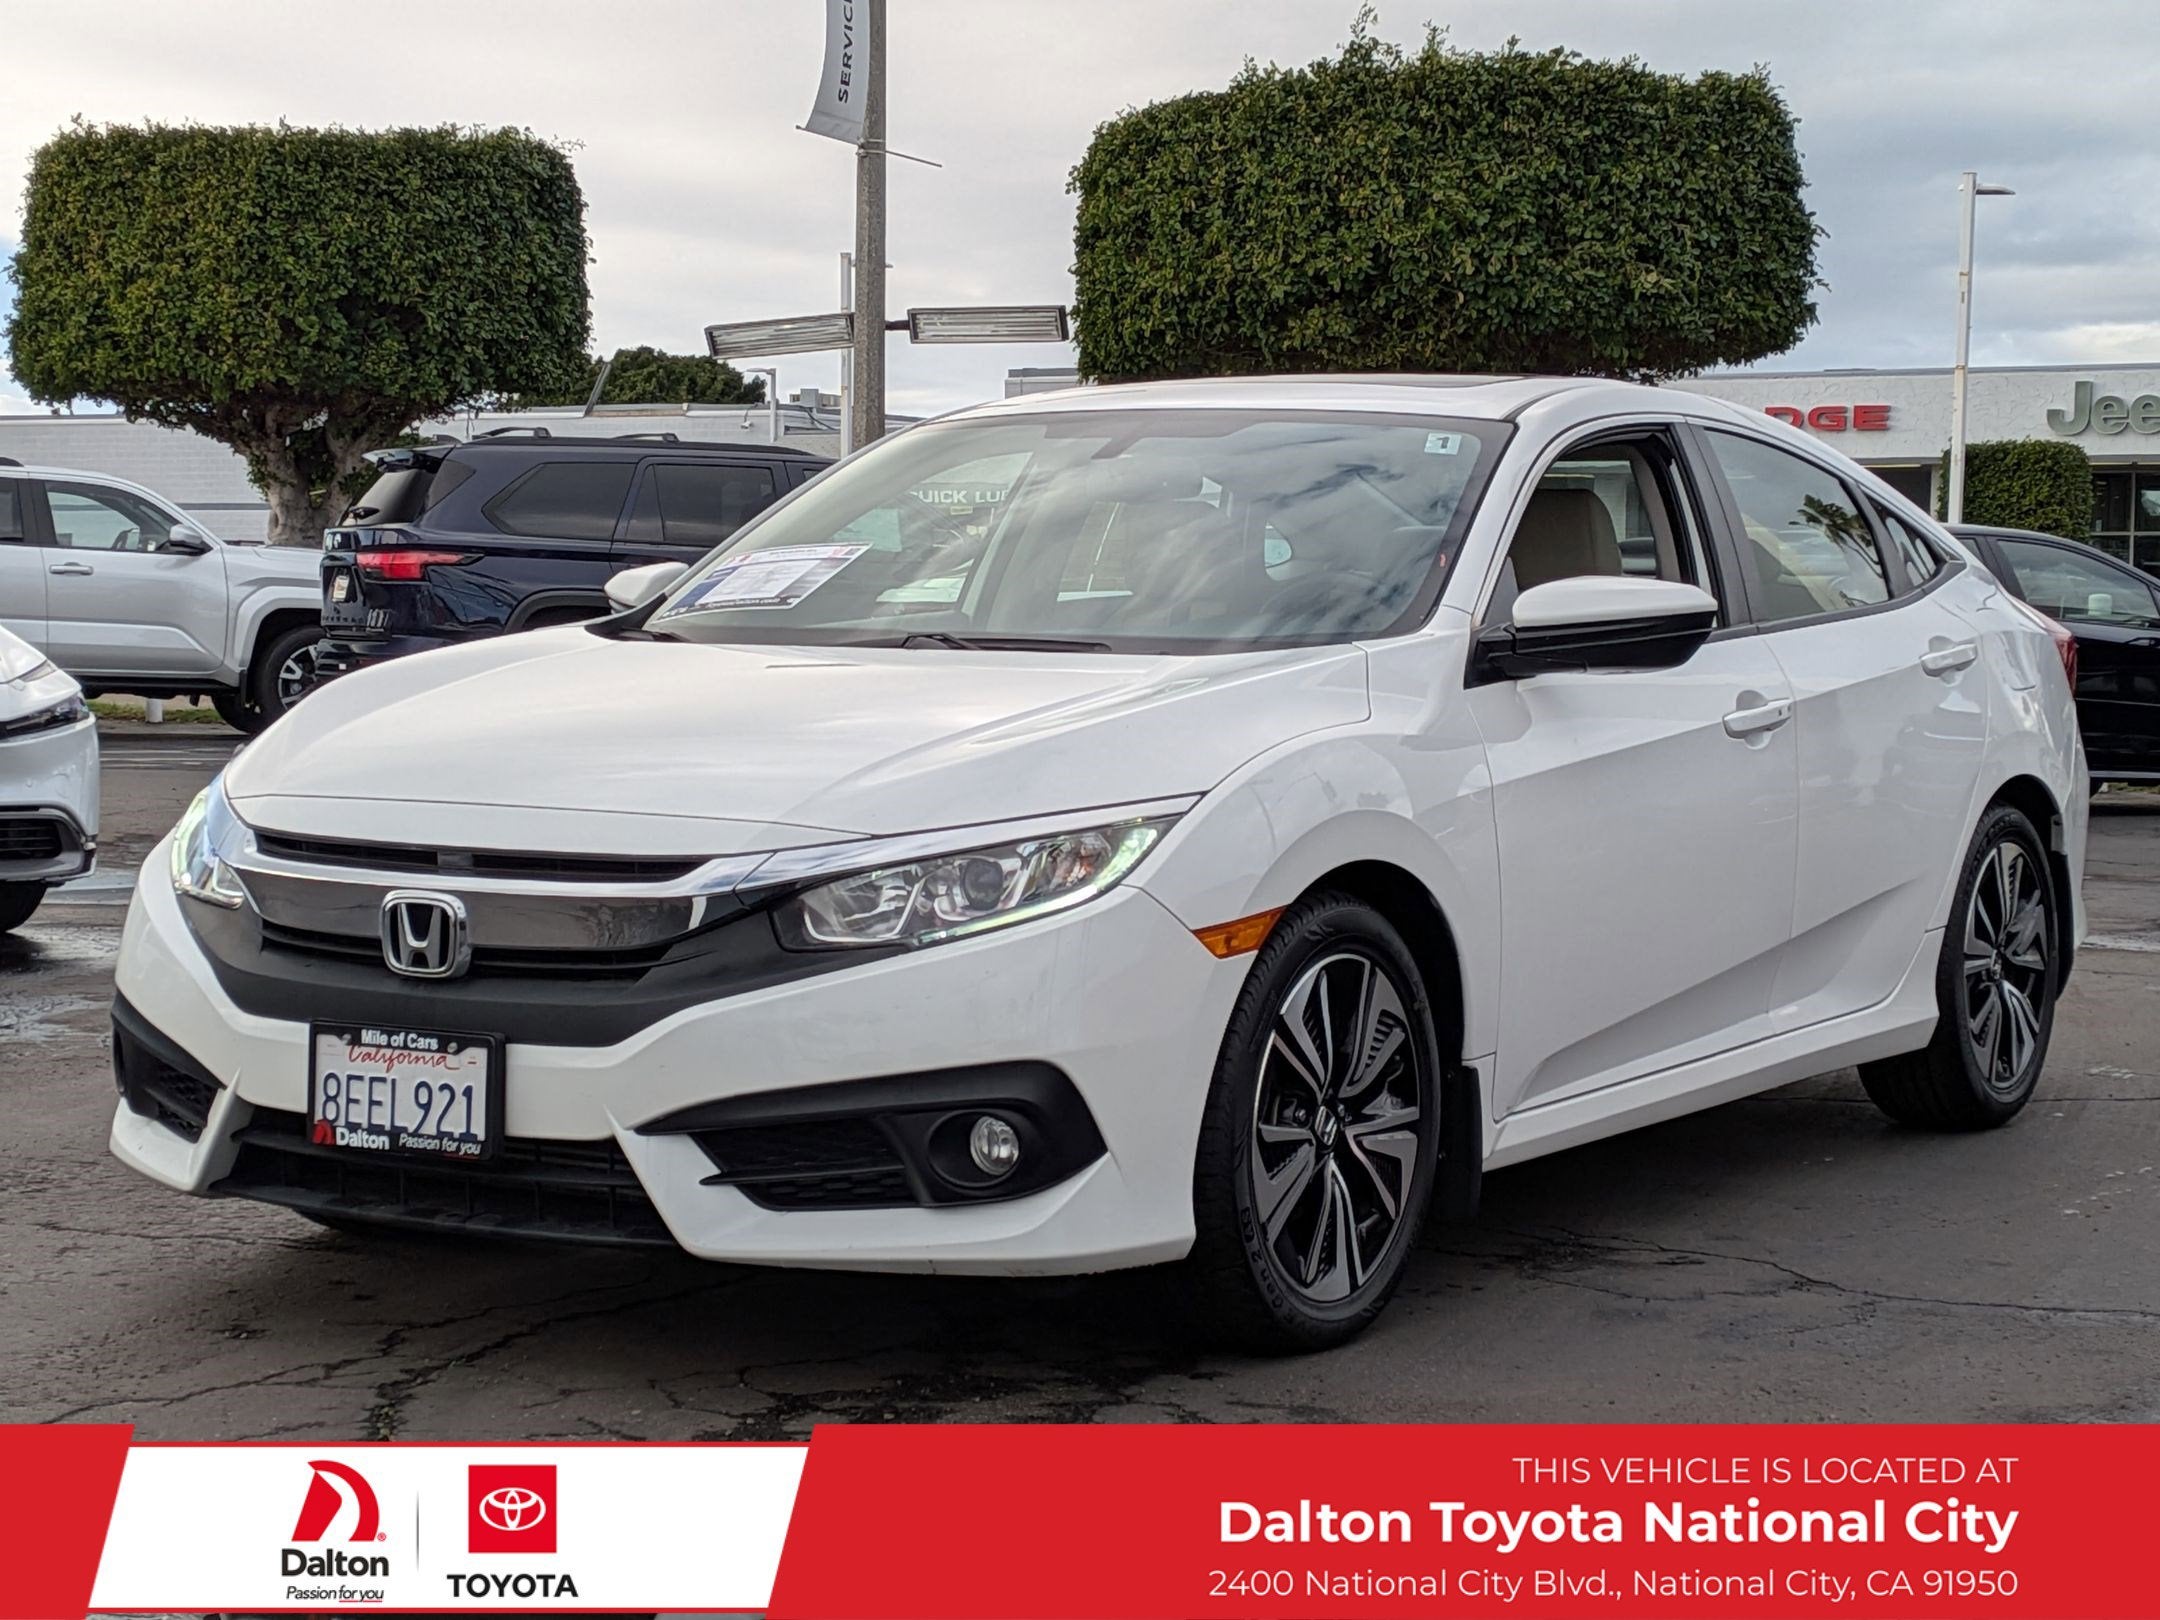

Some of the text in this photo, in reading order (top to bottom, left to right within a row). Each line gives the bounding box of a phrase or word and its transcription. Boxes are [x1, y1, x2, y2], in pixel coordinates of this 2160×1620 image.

[838, 0, 853, 103] SERVIC
[2047, 381, 2160, 436] Jee
[910, 490, 968, 504] UICK
[361, 1029, 439, 1051] Mile of Cars
[348, 1044, 460, 1074] California
[322, 1072, 478, 1142] 8EEL921
[335, 1127, 482, 1156] Dalton Passion for you
